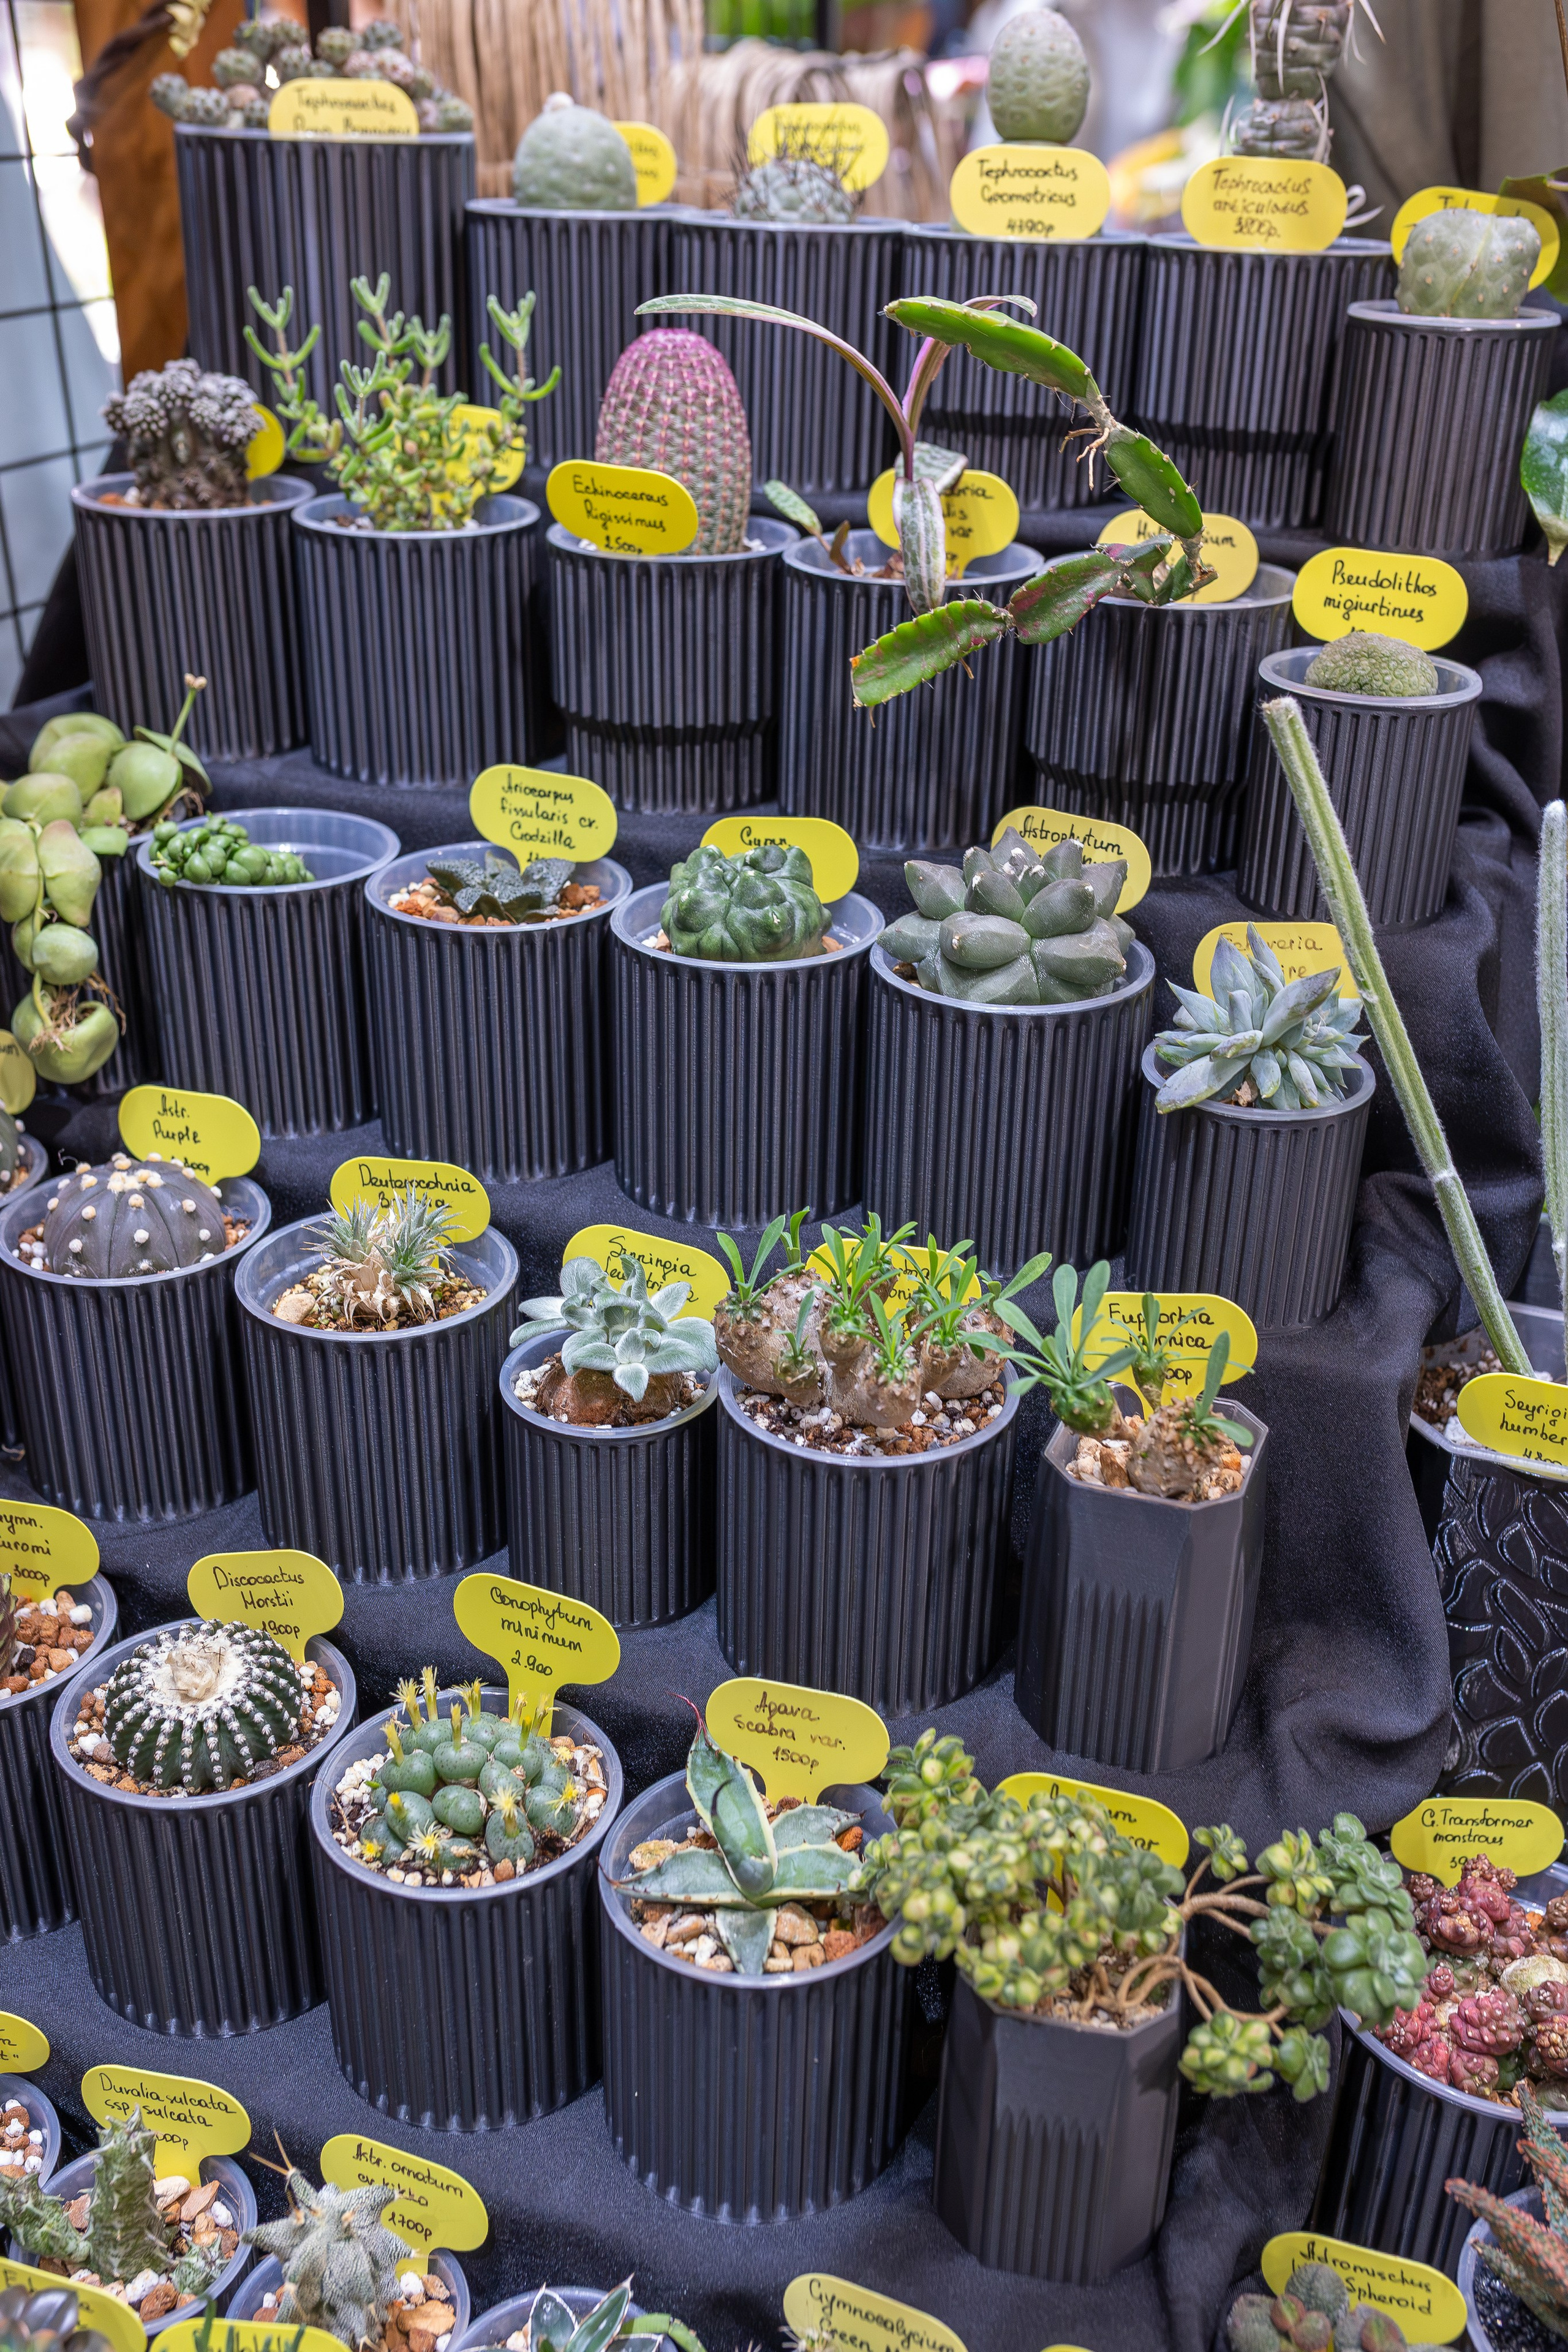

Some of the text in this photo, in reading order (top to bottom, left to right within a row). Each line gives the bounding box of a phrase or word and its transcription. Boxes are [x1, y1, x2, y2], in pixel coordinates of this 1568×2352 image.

[1332, 560, 1438, 597] Pseudolithos
[1109, 1302, 1215, 1332] Euporbia
[490, 1586, 594, 1631] Conophytum
